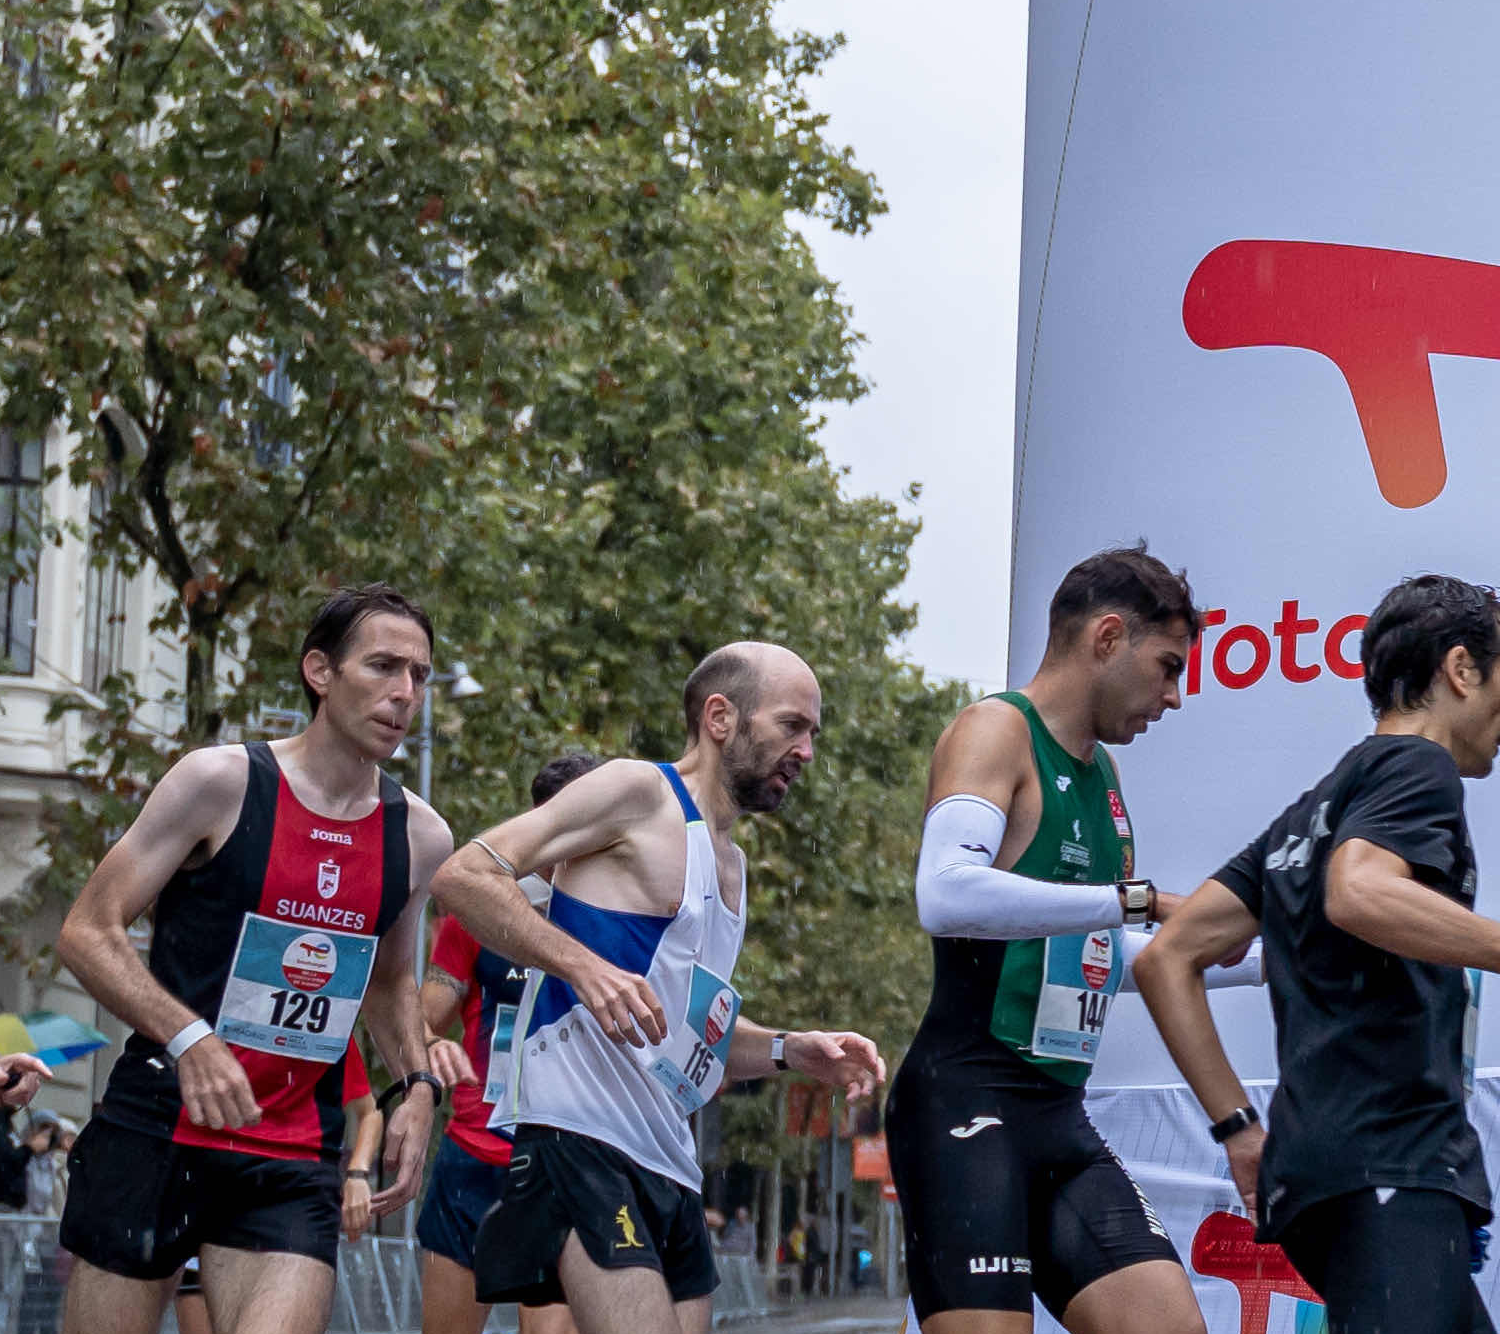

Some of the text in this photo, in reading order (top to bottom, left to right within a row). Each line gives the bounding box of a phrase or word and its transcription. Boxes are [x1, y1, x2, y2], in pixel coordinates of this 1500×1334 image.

[275, 898, 366, 930] SUANZES
[269, 990, 332, 1034] 129
[684, 1040, 715, 1088] 115
[969, 1256, 1008, 1274] UJI
